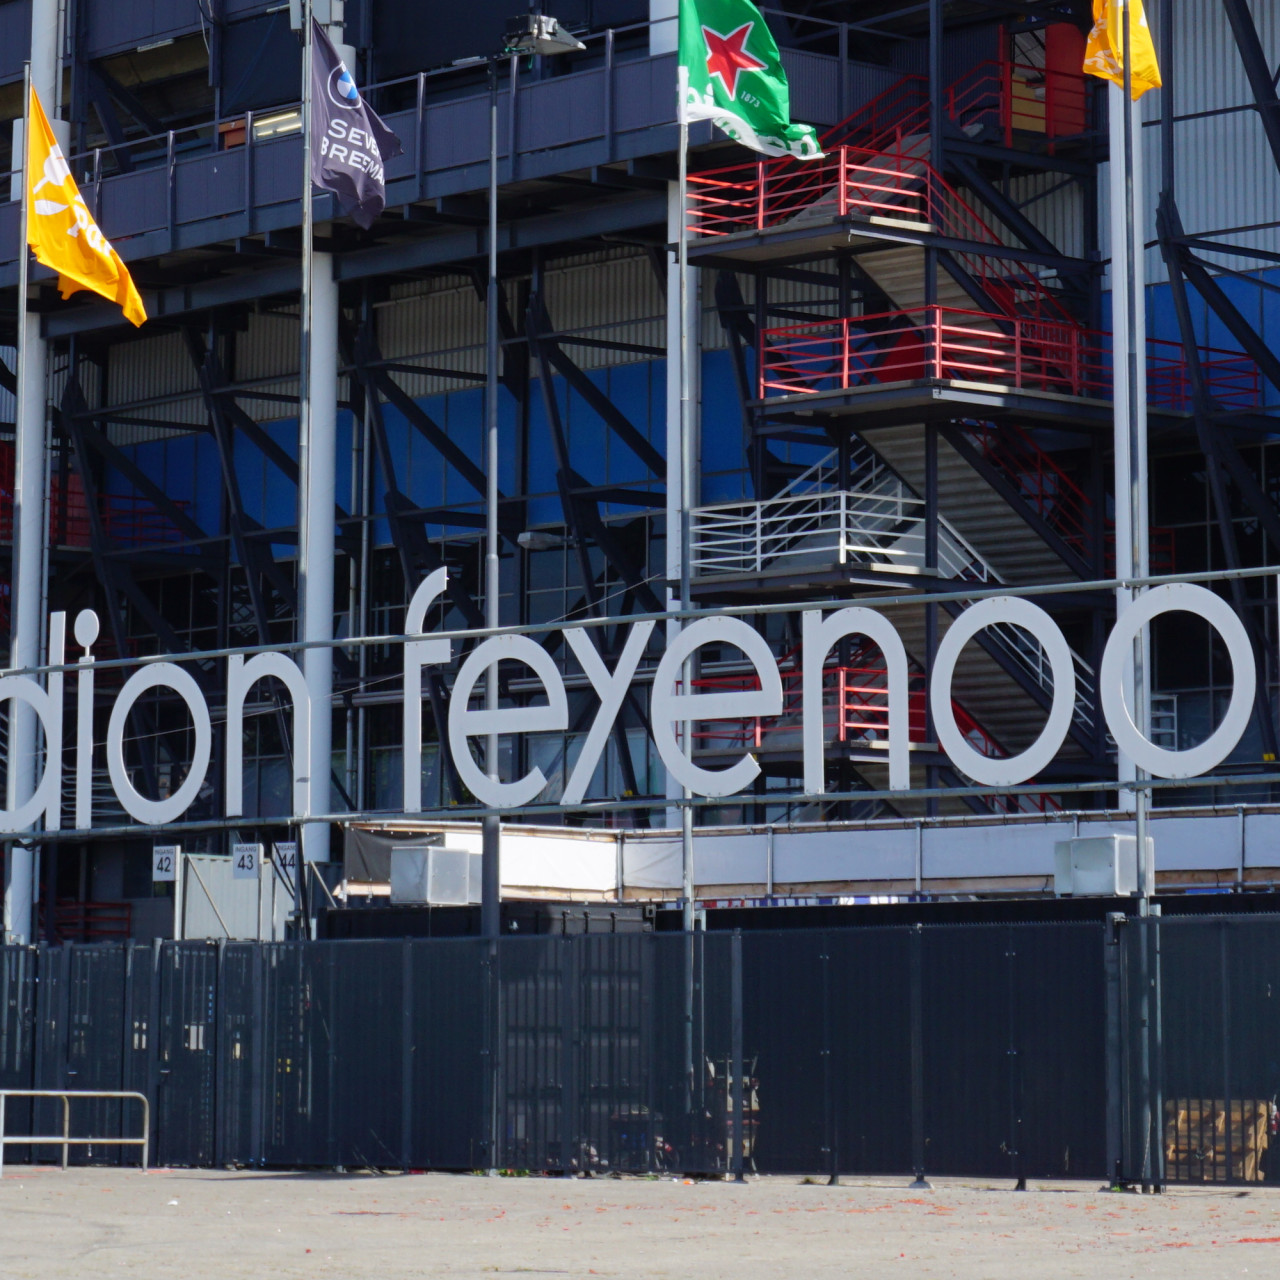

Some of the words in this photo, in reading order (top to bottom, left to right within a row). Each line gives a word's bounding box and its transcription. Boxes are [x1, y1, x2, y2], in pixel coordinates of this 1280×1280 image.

[740, 90, 761, 108] 1873
[328, 118, 380, 158] SEVE
[320, 136, 385, 186] BREEMA
[157, 856, 171, 872] 42
[237, 854, 254, 870] 43
[280, 853, 296, 869] 44
